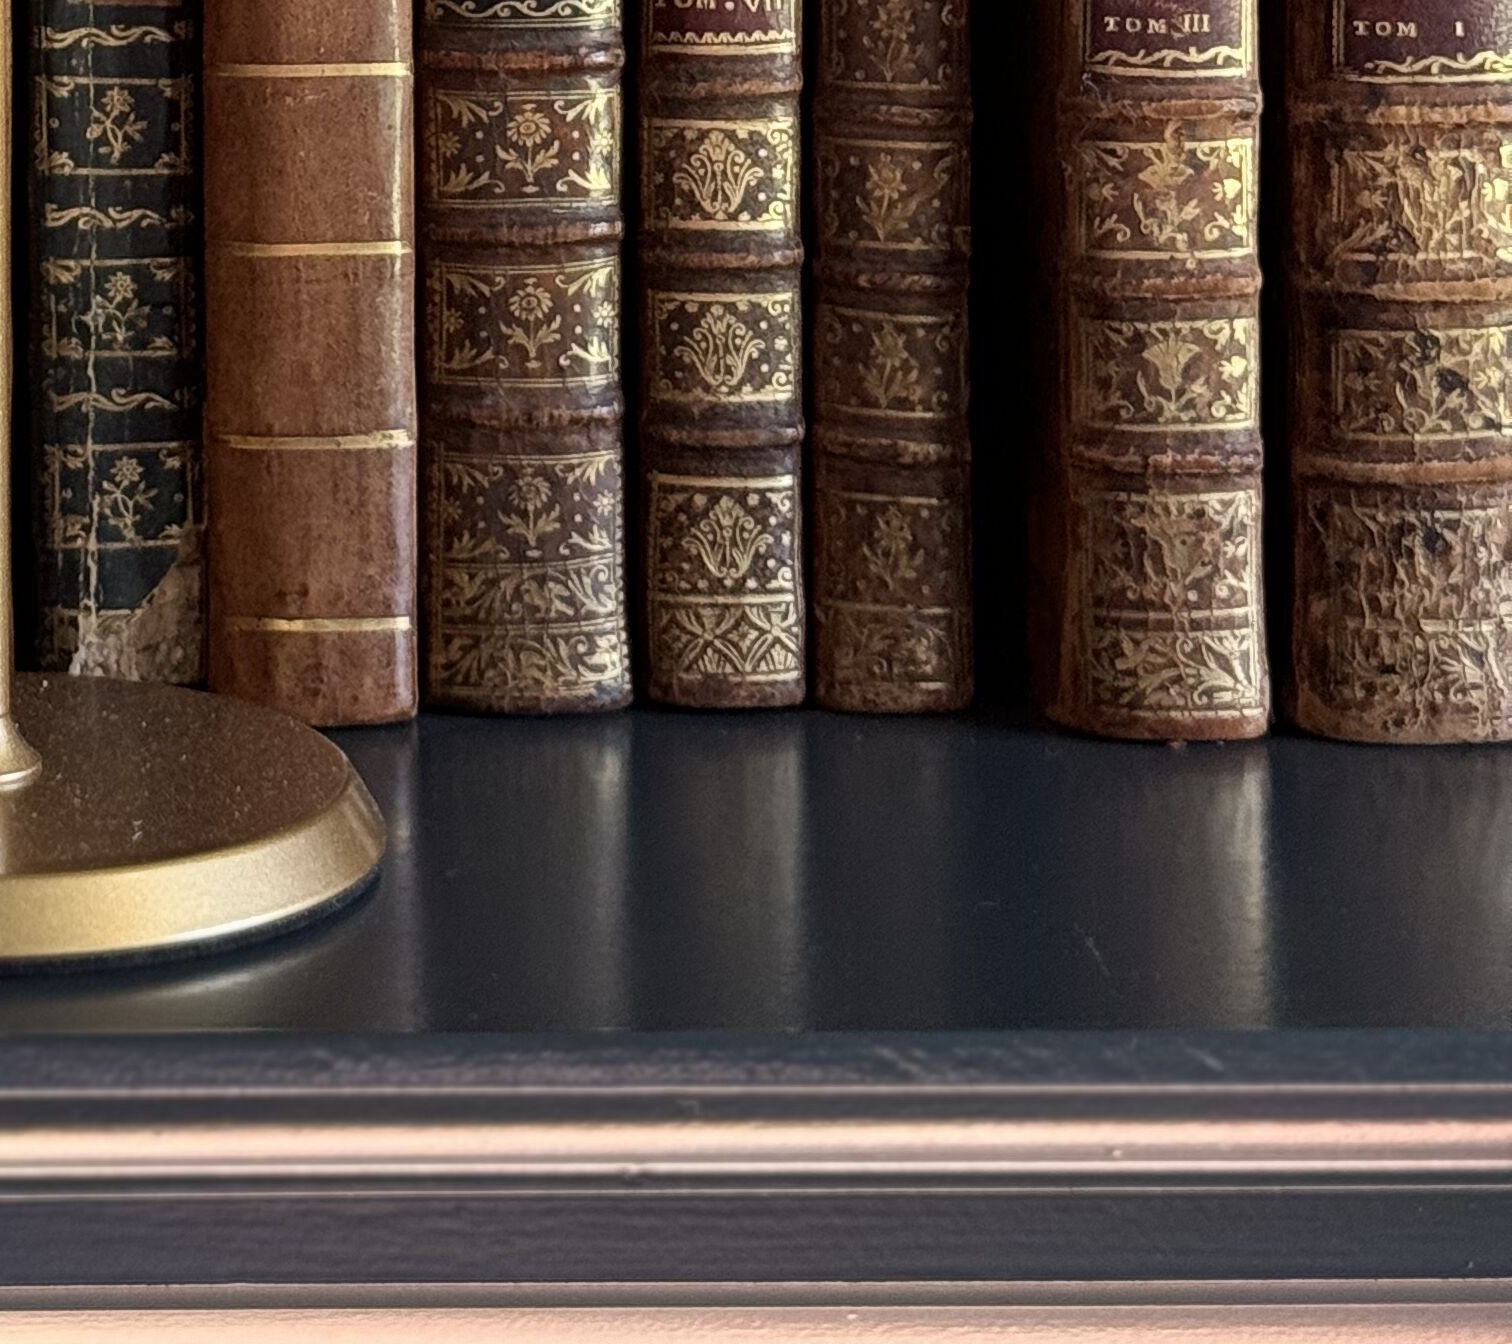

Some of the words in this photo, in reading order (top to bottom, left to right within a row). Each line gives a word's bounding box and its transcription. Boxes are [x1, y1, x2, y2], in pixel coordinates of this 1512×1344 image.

[1103, 15, 1168, 34] TOM
[1181, 13, 1211, 33] III
[1352, 20, 1418, 38] TOM
